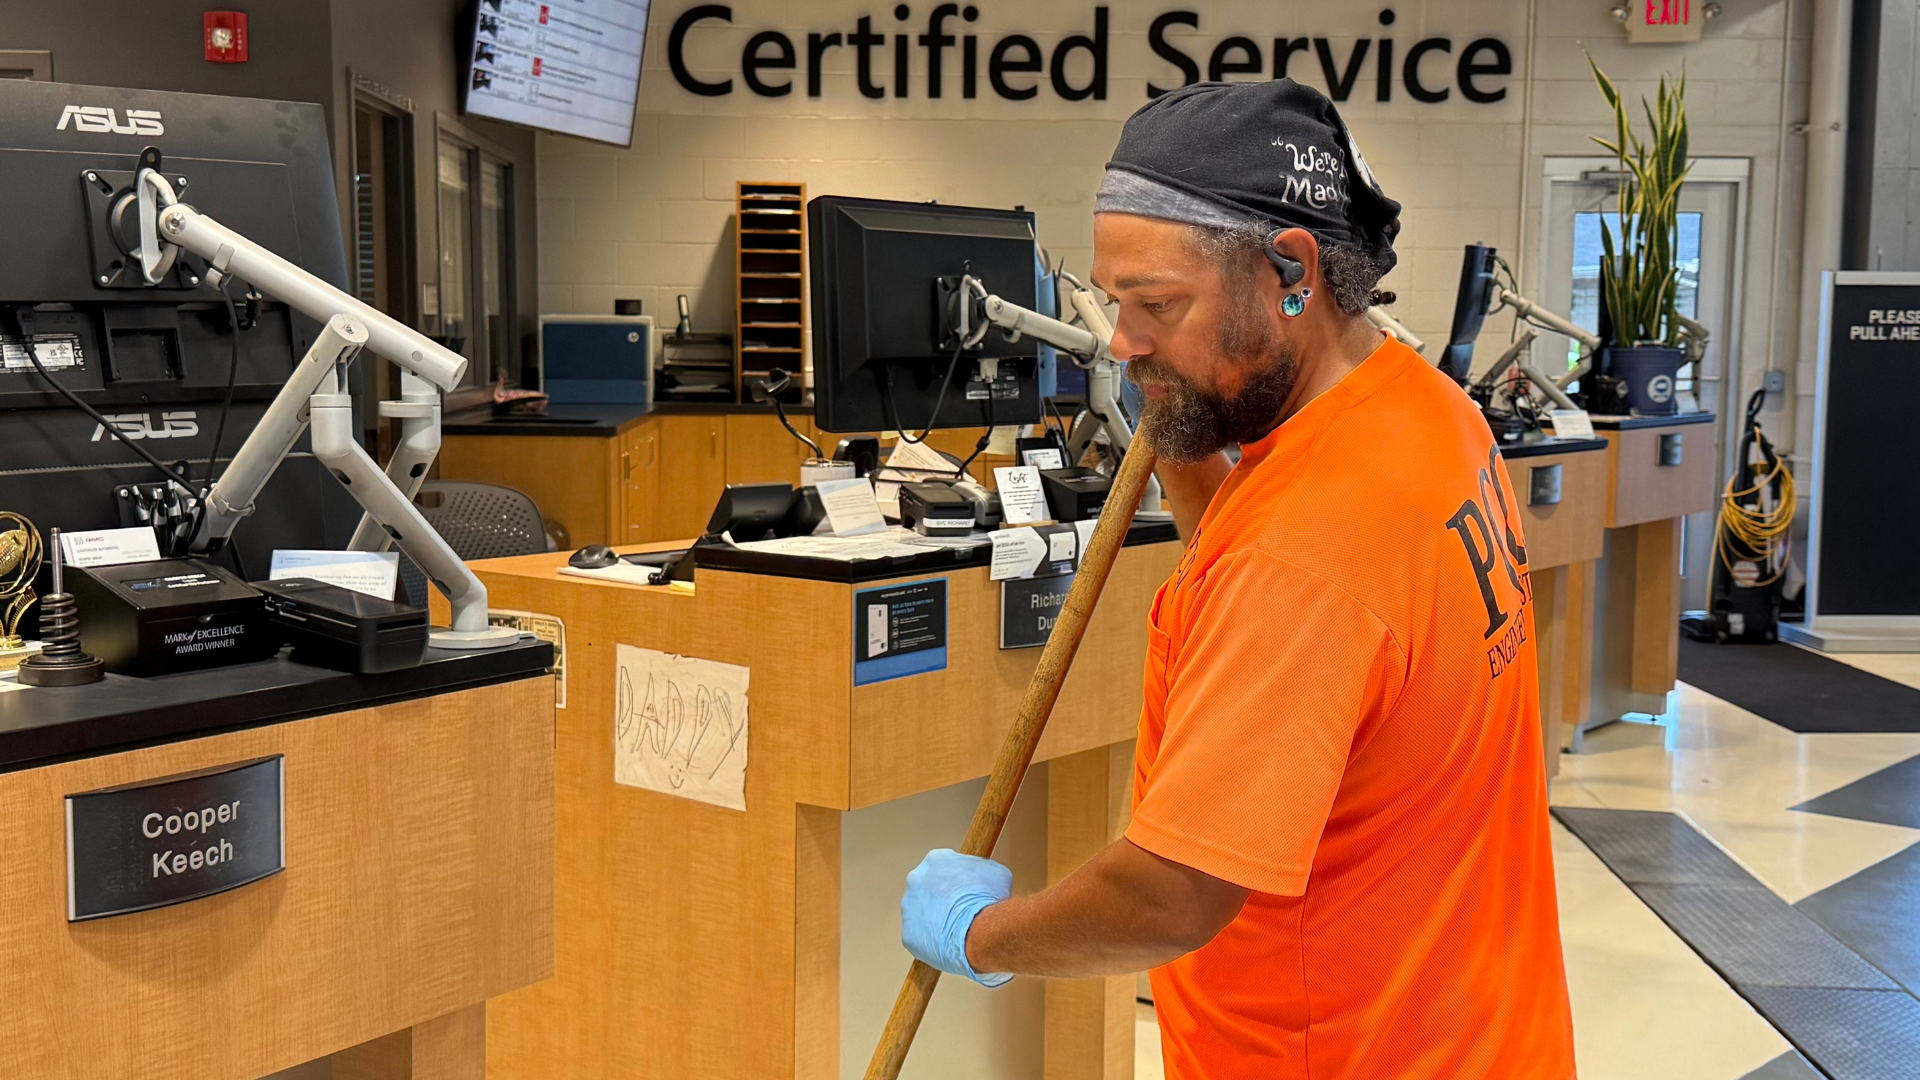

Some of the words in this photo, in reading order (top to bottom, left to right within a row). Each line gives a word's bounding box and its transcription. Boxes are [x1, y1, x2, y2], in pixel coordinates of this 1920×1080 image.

[1646, 0, 1690, 25] EXIT
[667, 3, 1110, 101] Certified
[1147, 9, 1512, 104] Service
[56, 104, 165, 136] ASUS
[1850, 326, 1887, 340] PULL
[91, 411, 199, 441] ASUS
[1031, 592, 1069, 609] Richar
[164, 631, 188, 644] MARK
[197, 624, 245, 640] EXCELLENCE
[175, 642, 204, 655] AWARD
[204, 638, 236, 651] WINNER
[618, 665, 745, 780] DADDY
[142, 800, 241, 839] Cooper
[153, 838, 234, 878] Keech
